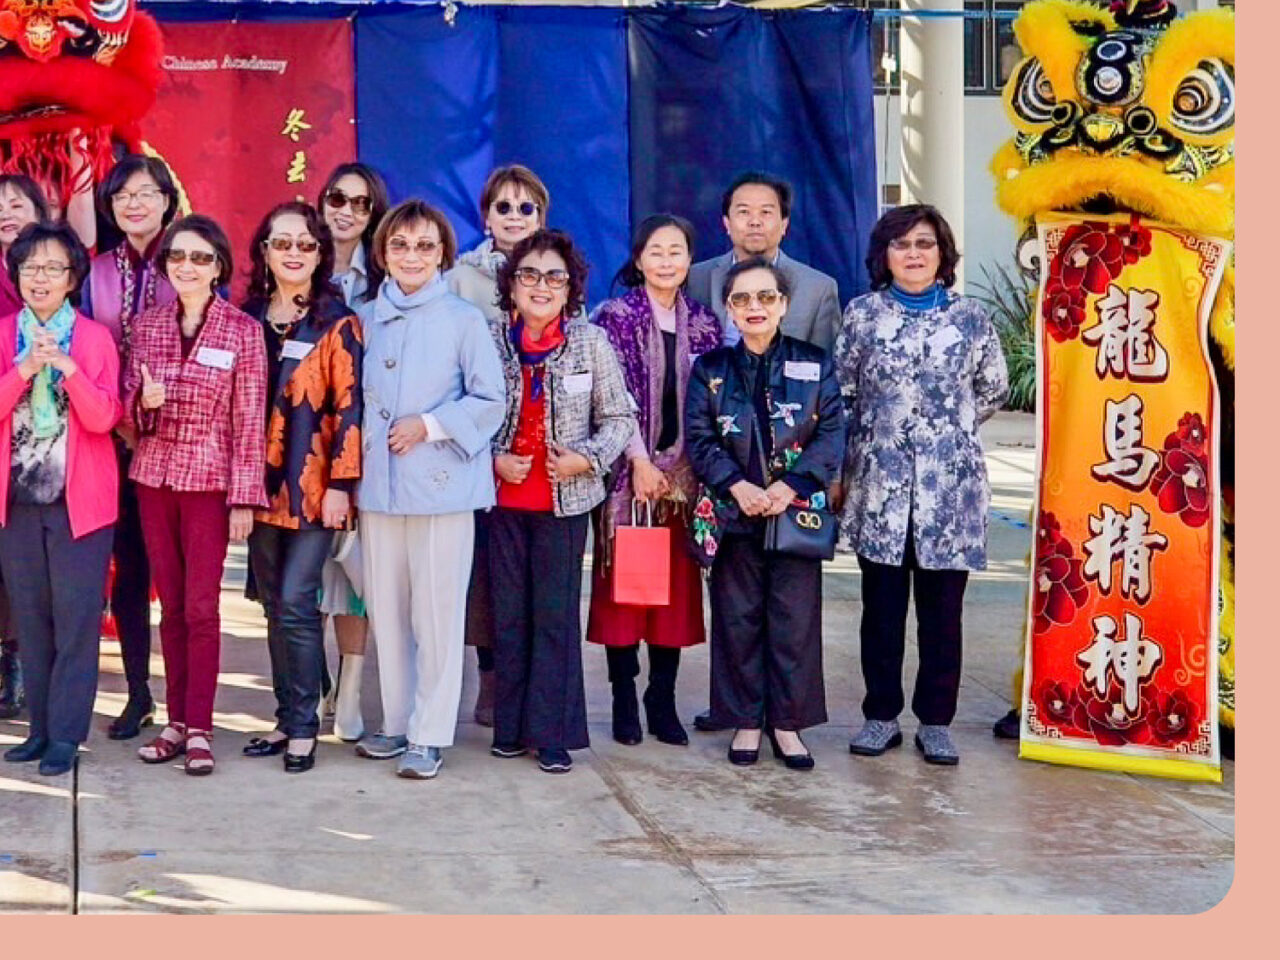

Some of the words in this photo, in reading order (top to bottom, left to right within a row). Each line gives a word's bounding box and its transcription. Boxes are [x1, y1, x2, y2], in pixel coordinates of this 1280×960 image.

[220, 53, 289, 75] Academy
[1079, 283, 1169, 716] 龍馬精神
